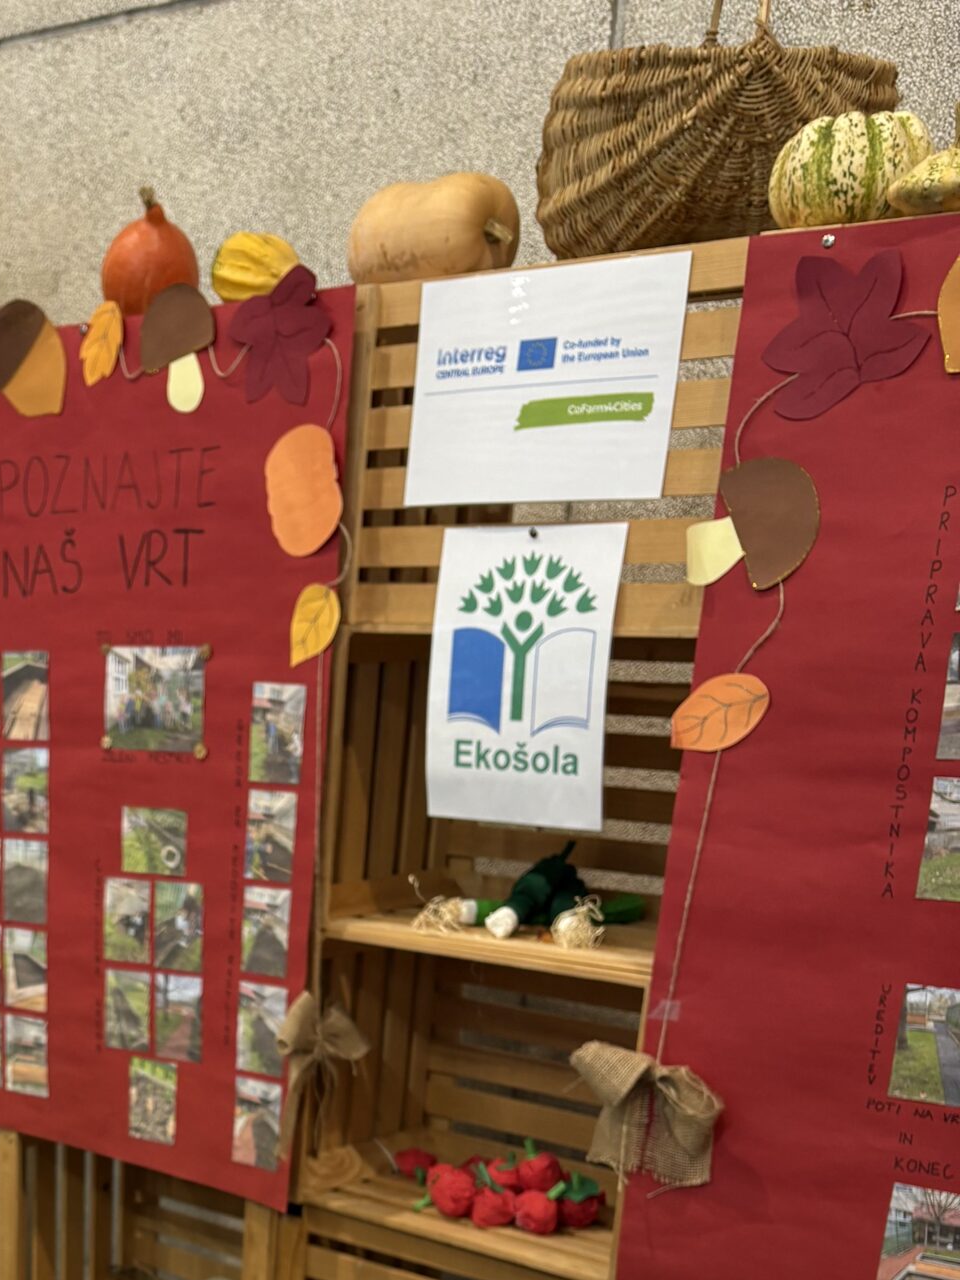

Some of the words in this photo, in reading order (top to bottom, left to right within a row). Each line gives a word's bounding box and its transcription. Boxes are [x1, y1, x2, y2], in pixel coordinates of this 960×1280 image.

[563, 337, 608, 350] Co-funded
[610, 336, 621, 348] by
[437, 346, 508, 366] Interreg
[561, 352, 576, 363] the
[578, 349, 619, 363] European
[621, 347, 649, 359] Union
[436, 367, 470, 380] CENTRAL
[472, 365, 504, 377] EUROPE
[2, 528, 83, 599] NAŠ
[118, 526, 206, 591] VRT
[915, 485, 957, 673] PRIPRAVA
[454, 739, 579, 776] Ekošola
[881, 688, 922, 899] KOMPOSTNIKA
[865, 1098, 902, 1115] POTI
[913, 1108, 934, 1120] NA
[898, 1132, 913, 1146] IN
[894, 1156, 954, 1179] KONEC
